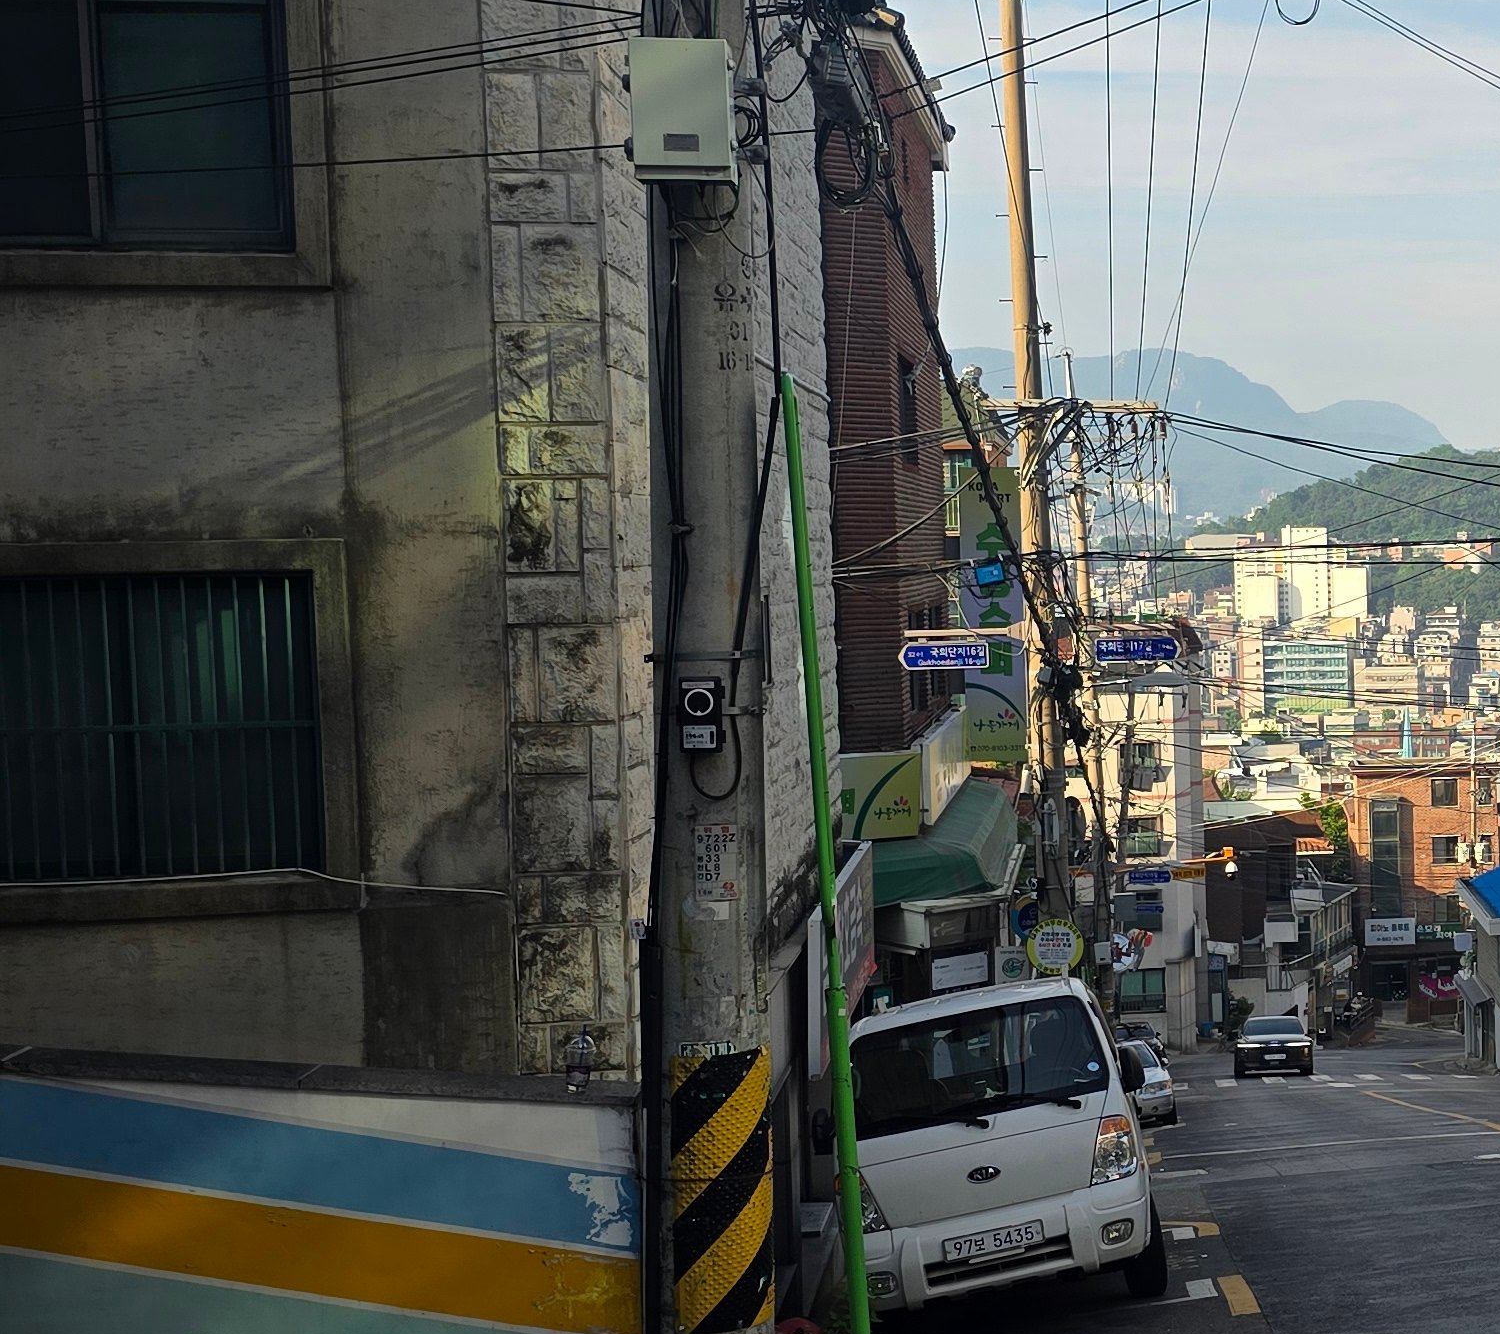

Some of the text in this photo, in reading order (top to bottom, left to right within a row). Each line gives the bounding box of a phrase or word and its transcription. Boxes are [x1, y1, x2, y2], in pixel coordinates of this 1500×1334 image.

[968, 481, 998, 491] KOA
[978, 493, 1011, 503] MRT
[930, 645, 985, 658] 국회단지16길
[972, 1167, 996, 1180] KIA
[953, 1226, 1034, 1256] 97보 5435
